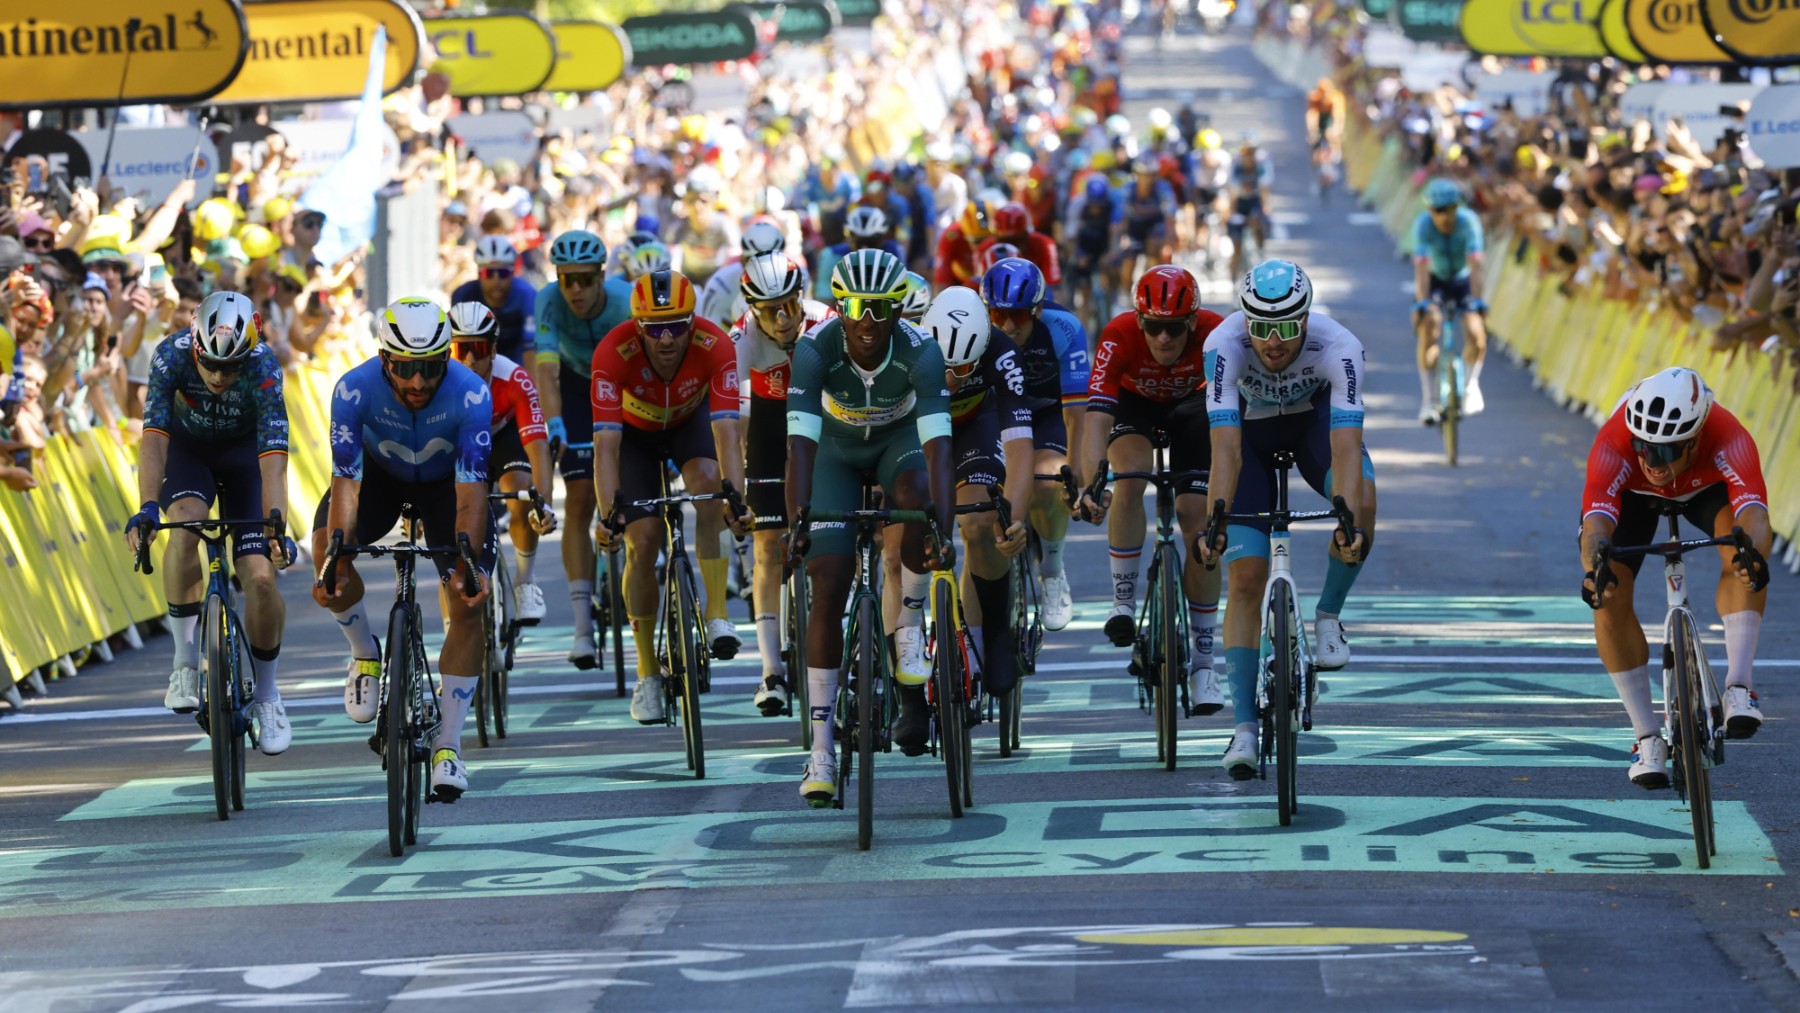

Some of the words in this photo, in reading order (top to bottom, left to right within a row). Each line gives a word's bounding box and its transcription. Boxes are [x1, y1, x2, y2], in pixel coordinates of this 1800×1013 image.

[0, 14, 176, 56] tinental
[995, 350, 1024, 396] lotto
[1090, 341, 1118, 392] ARKEA
[1214, 354, 1226, 404] MERIDA
[1243, 376, 1319, 396] BAHRAIN
[1341, 358, 1356, 405] MERIDA
[1607, 459, 1633, 497] GIANT
[1714, 451, 1746, 487] GIANT
[810, 520, 847, 531] Santini
[862, 547, 870, 586] CUBE
[922, 843, 1681, 870] cycling
